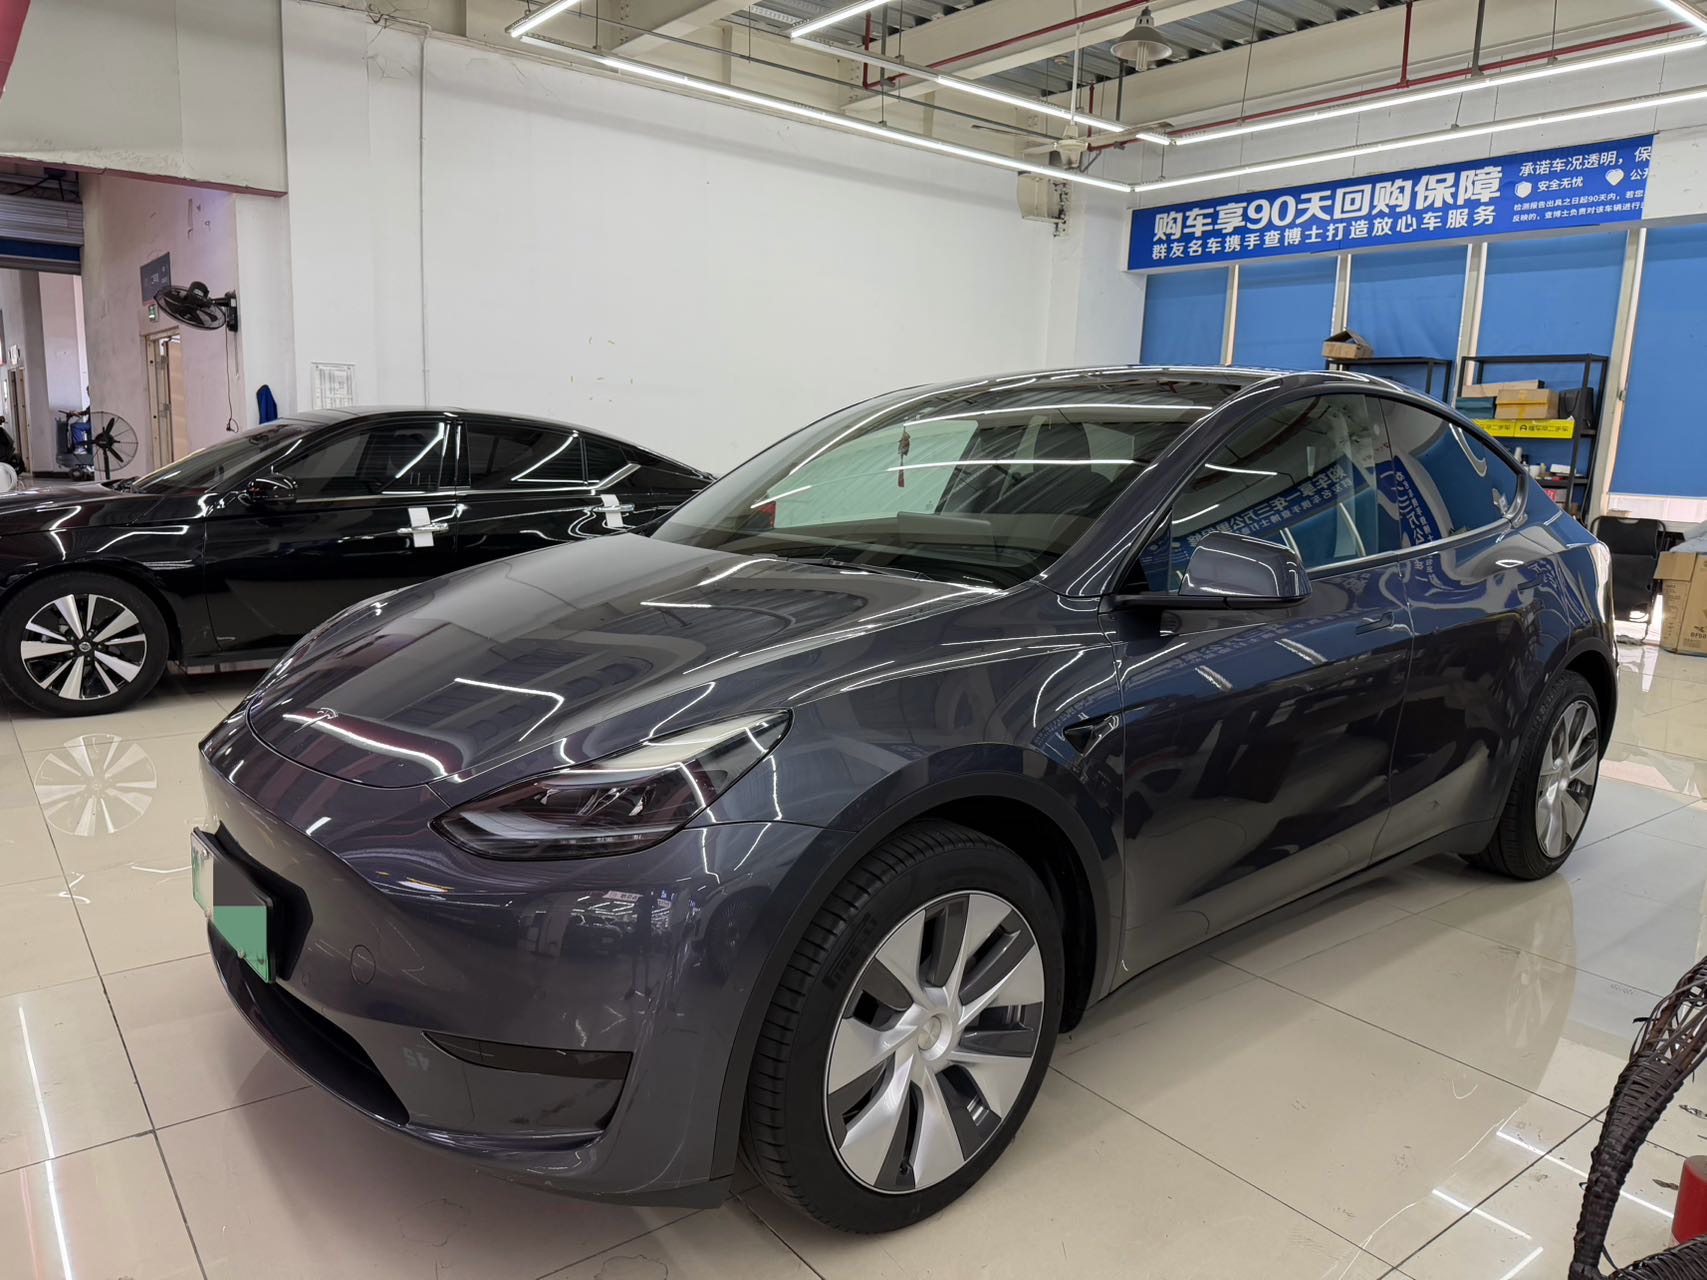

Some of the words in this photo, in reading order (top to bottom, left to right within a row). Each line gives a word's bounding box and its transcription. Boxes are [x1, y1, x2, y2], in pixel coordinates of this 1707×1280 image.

[1537, 176, 1584, 192] 安全无忧
[1153, 165, 1503, 242] 购车享90天回购保障
[1512, 201, 1644, 223] 反映的，查博士负责对该车辆进行
[1152, 205, 1496, 260] 群友名车携手查博士打造放心车服务
